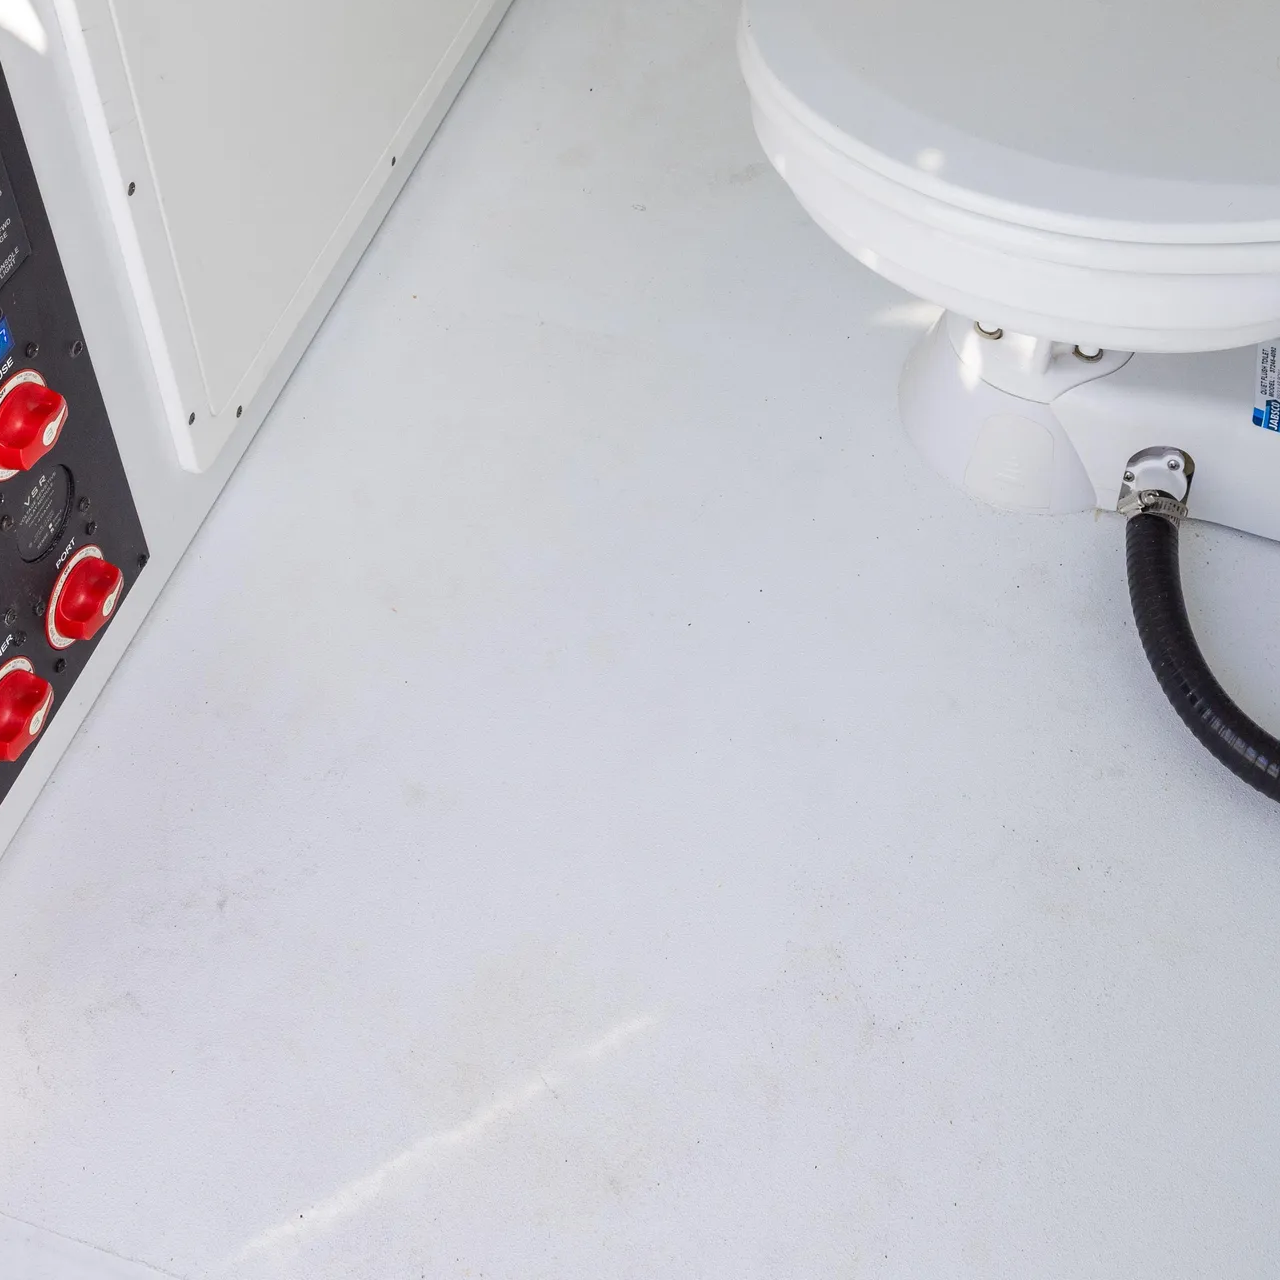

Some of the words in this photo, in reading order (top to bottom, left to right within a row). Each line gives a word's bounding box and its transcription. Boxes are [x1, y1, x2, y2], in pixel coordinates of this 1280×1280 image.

[0, 257, 16, 279] LIGHT
[1260, 380, 1268, 395] QUIET
[1269, 401, 1280, 431] JABSCO
[55, 536, 76, 570] PORT
